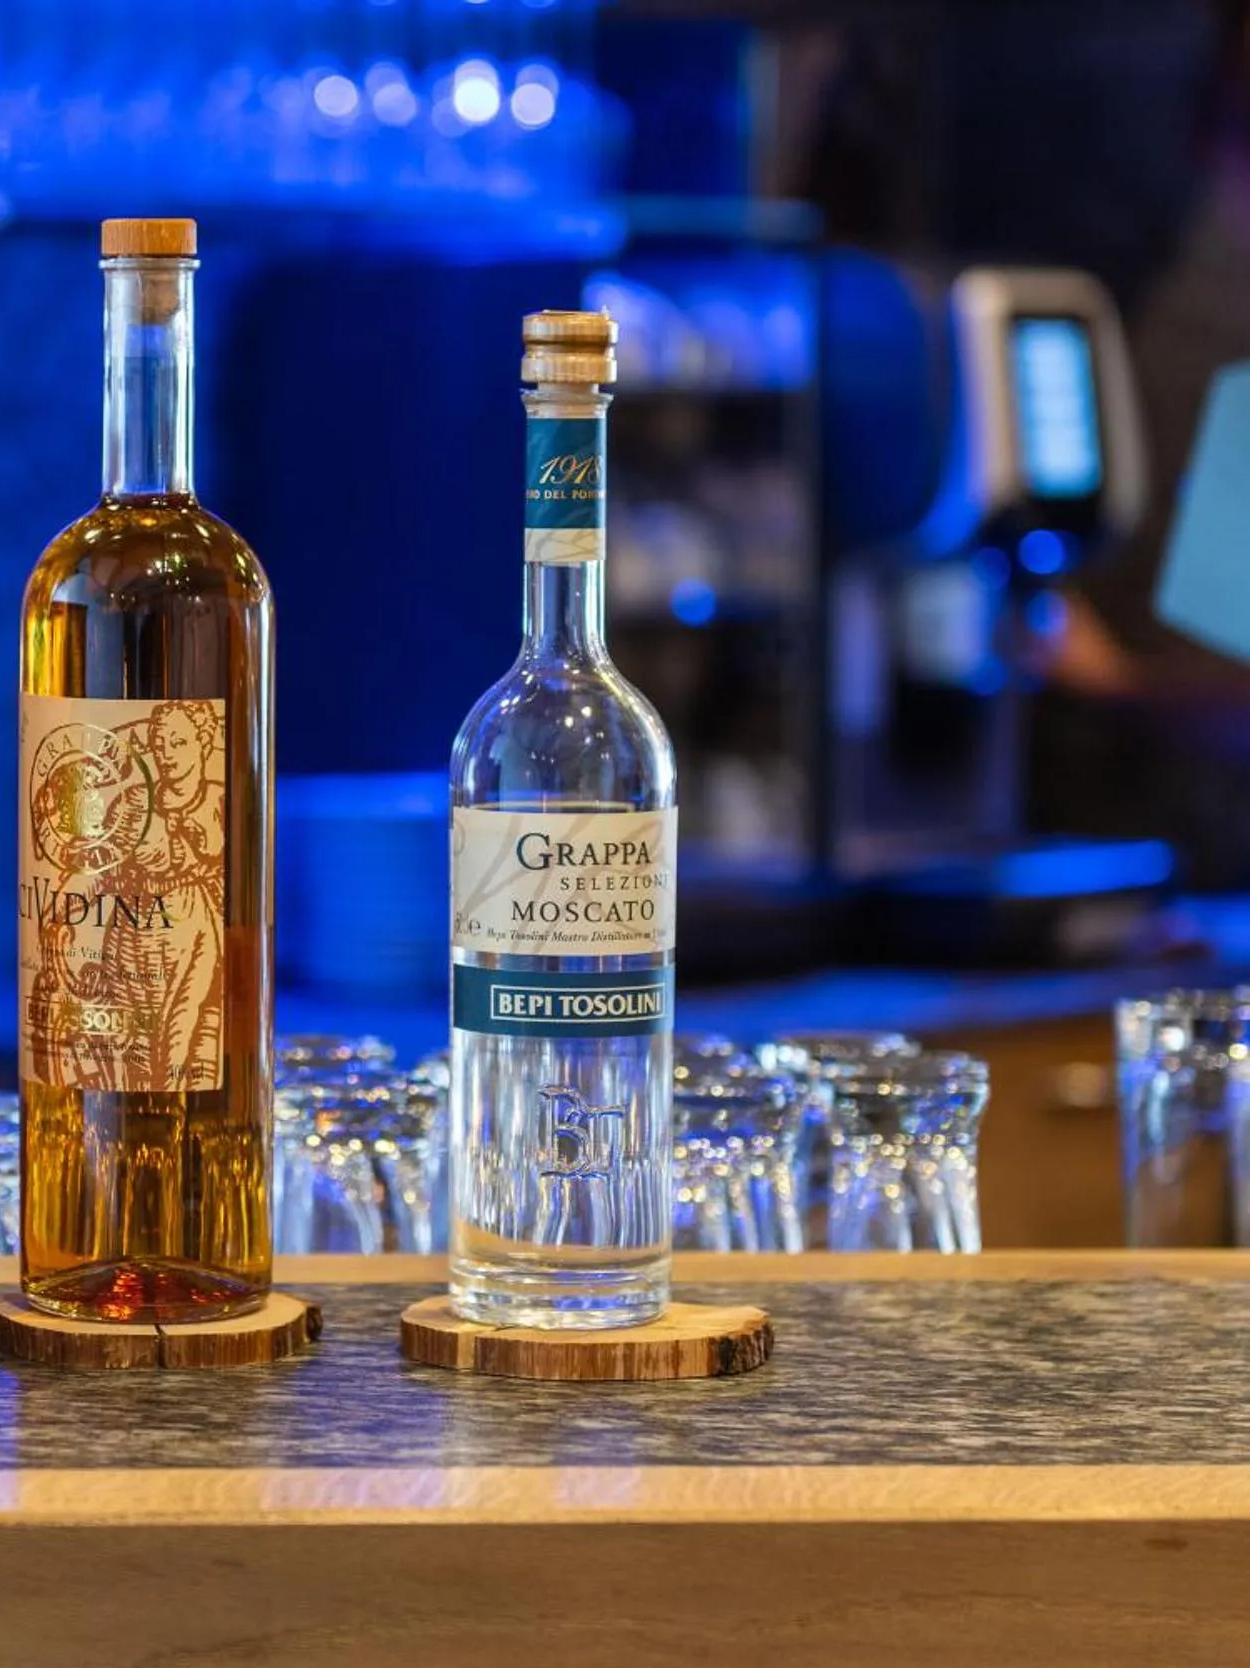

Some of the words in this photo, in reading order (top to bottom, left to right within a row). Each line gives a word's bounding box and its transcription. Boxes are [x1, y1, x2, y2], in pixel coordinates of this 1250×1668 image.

[516, 832, 652, 871] GRAPPA
[511, 900, 655, 922] MOSCATO
[499, 992, 553, 1016] BEPI
[558, 991, 661, 1017] TOSOLINI
